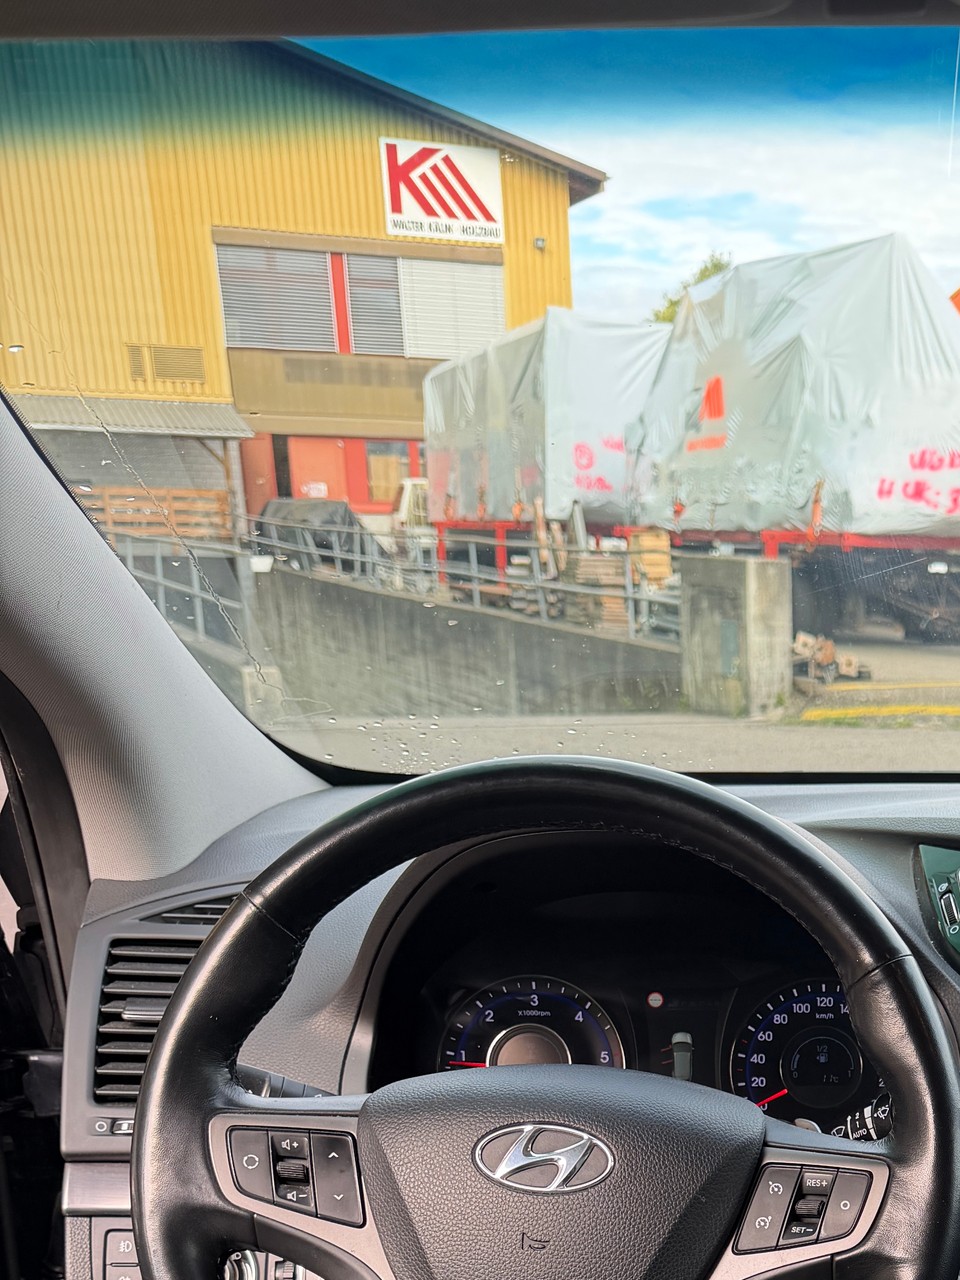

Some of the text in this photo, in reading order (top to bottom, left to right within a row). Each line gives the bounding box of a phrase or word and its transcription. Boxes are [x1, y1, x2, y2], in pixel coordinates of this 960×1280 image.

[530, 995, 539, 1006] 3
[816, 997, 834, 1007] 120
[792, 1003, 811, 1014] 100
[839, 1004, 850, 1014] 14
[484, 1010, 495, 1022] 2
[574, 1012, 584, 1023] 4
[773, 1014, 788, 1024] 80
[757, 1031, 773, 1042] 60
[600, 1051, 609, 1063] 5
[750, 1054, 766, 1064] 40
[751, 1077, 766, 1087] 20
[852, 1128, 868, 1139] AUTO
